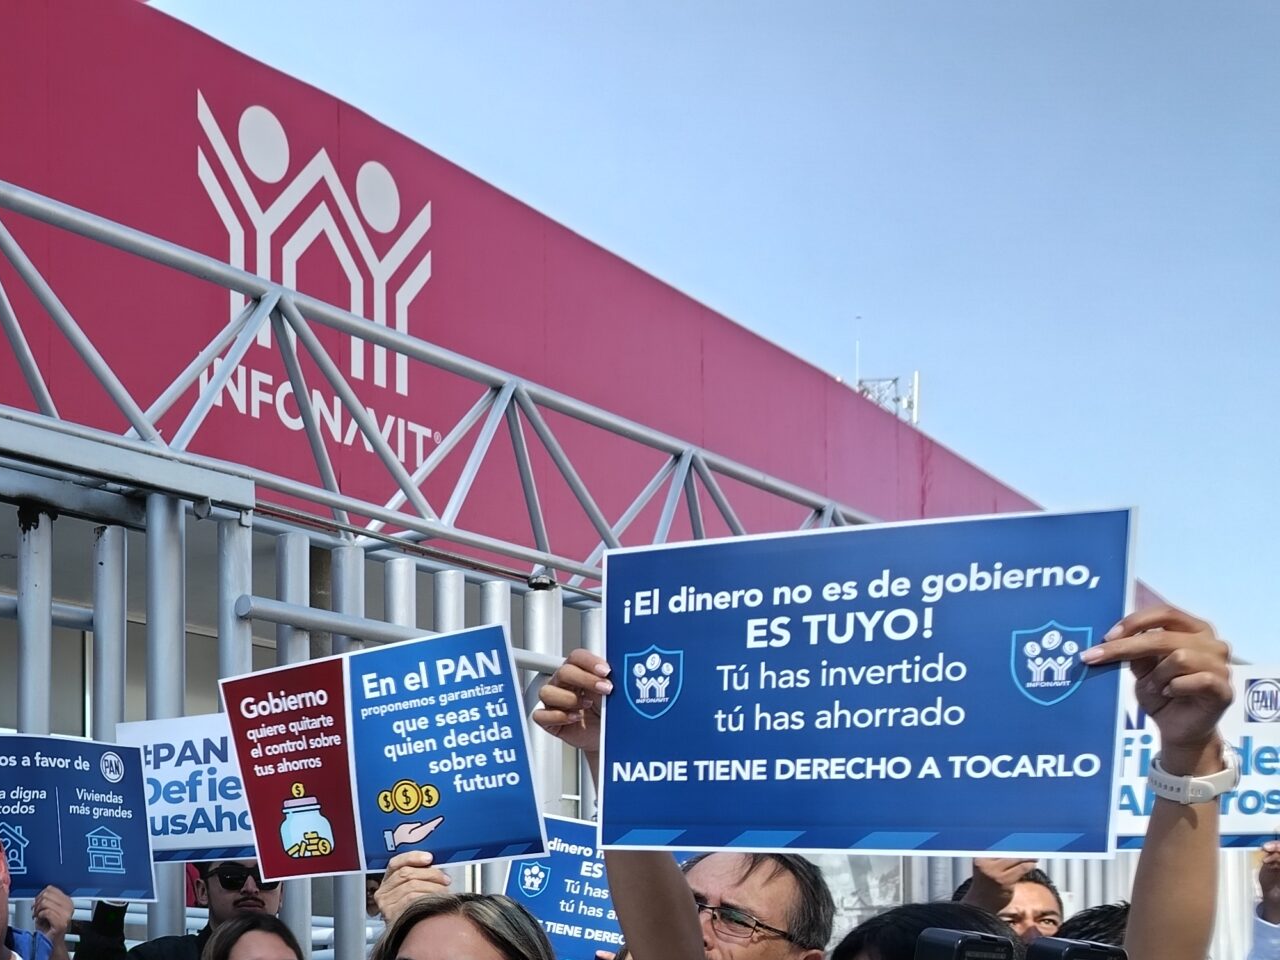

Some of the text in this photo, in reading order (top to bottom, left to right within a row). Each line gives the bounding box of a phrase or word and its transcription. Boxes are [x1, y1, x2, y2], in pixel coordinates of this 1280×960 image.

[623, 562, 1101, 624] ¡El dinero no es de gobierno,
[746, 607, 933, 649] ES TUYO!
[362, 649, 502, 699] En el PAN
[716, 652, 967, 691] Tú has invertido
[240, 689, 328, 719] Gobierno
[361, 683, 504, 720] proponemos garantizar
[714, 696, 966, 732] tú has ahorrado
[246, 715, 334, 743] quiere quitarte
[392, 698, 508, 738] que seas tú
[250, 733, 341, 758] el control sobre
[384, 722, 513, 762] quien decida
[21, 756, 31, 767] a
[34, 752, 71, 769] favor
[74, 756, 91, 771] de
[103, 758, 123, 776] PAN
[254, 757, 322, 777] tus ahorros
[428, 748, 517, 774] sobre tu
[612, 760, 688, 782] NADIE
[693, 759, 768, 781] TIENE
[775, 756, 912, 780] DERECHO
[917, 756, 942, 779] A
[948, 753, 1102, 779] TOCARLO
[10, 786, 47, 802] digna
[453, 771, 520, 793] futuro
[75, 788, 123, 804] Viviendas
[69, 802, 132, 819] más grandes
[149, 804, 252, 837] usAho
[547, 837, 593, 857] dinero
[580, 861, 604, 878] ES
[564, 878, 609, 899] Tú has
[559, 899, 574, 913] tú
[578, 901, 603, 917] has
[545, 921, 582, 937] TIENE
[584, 928, 625, 945] DEREC
